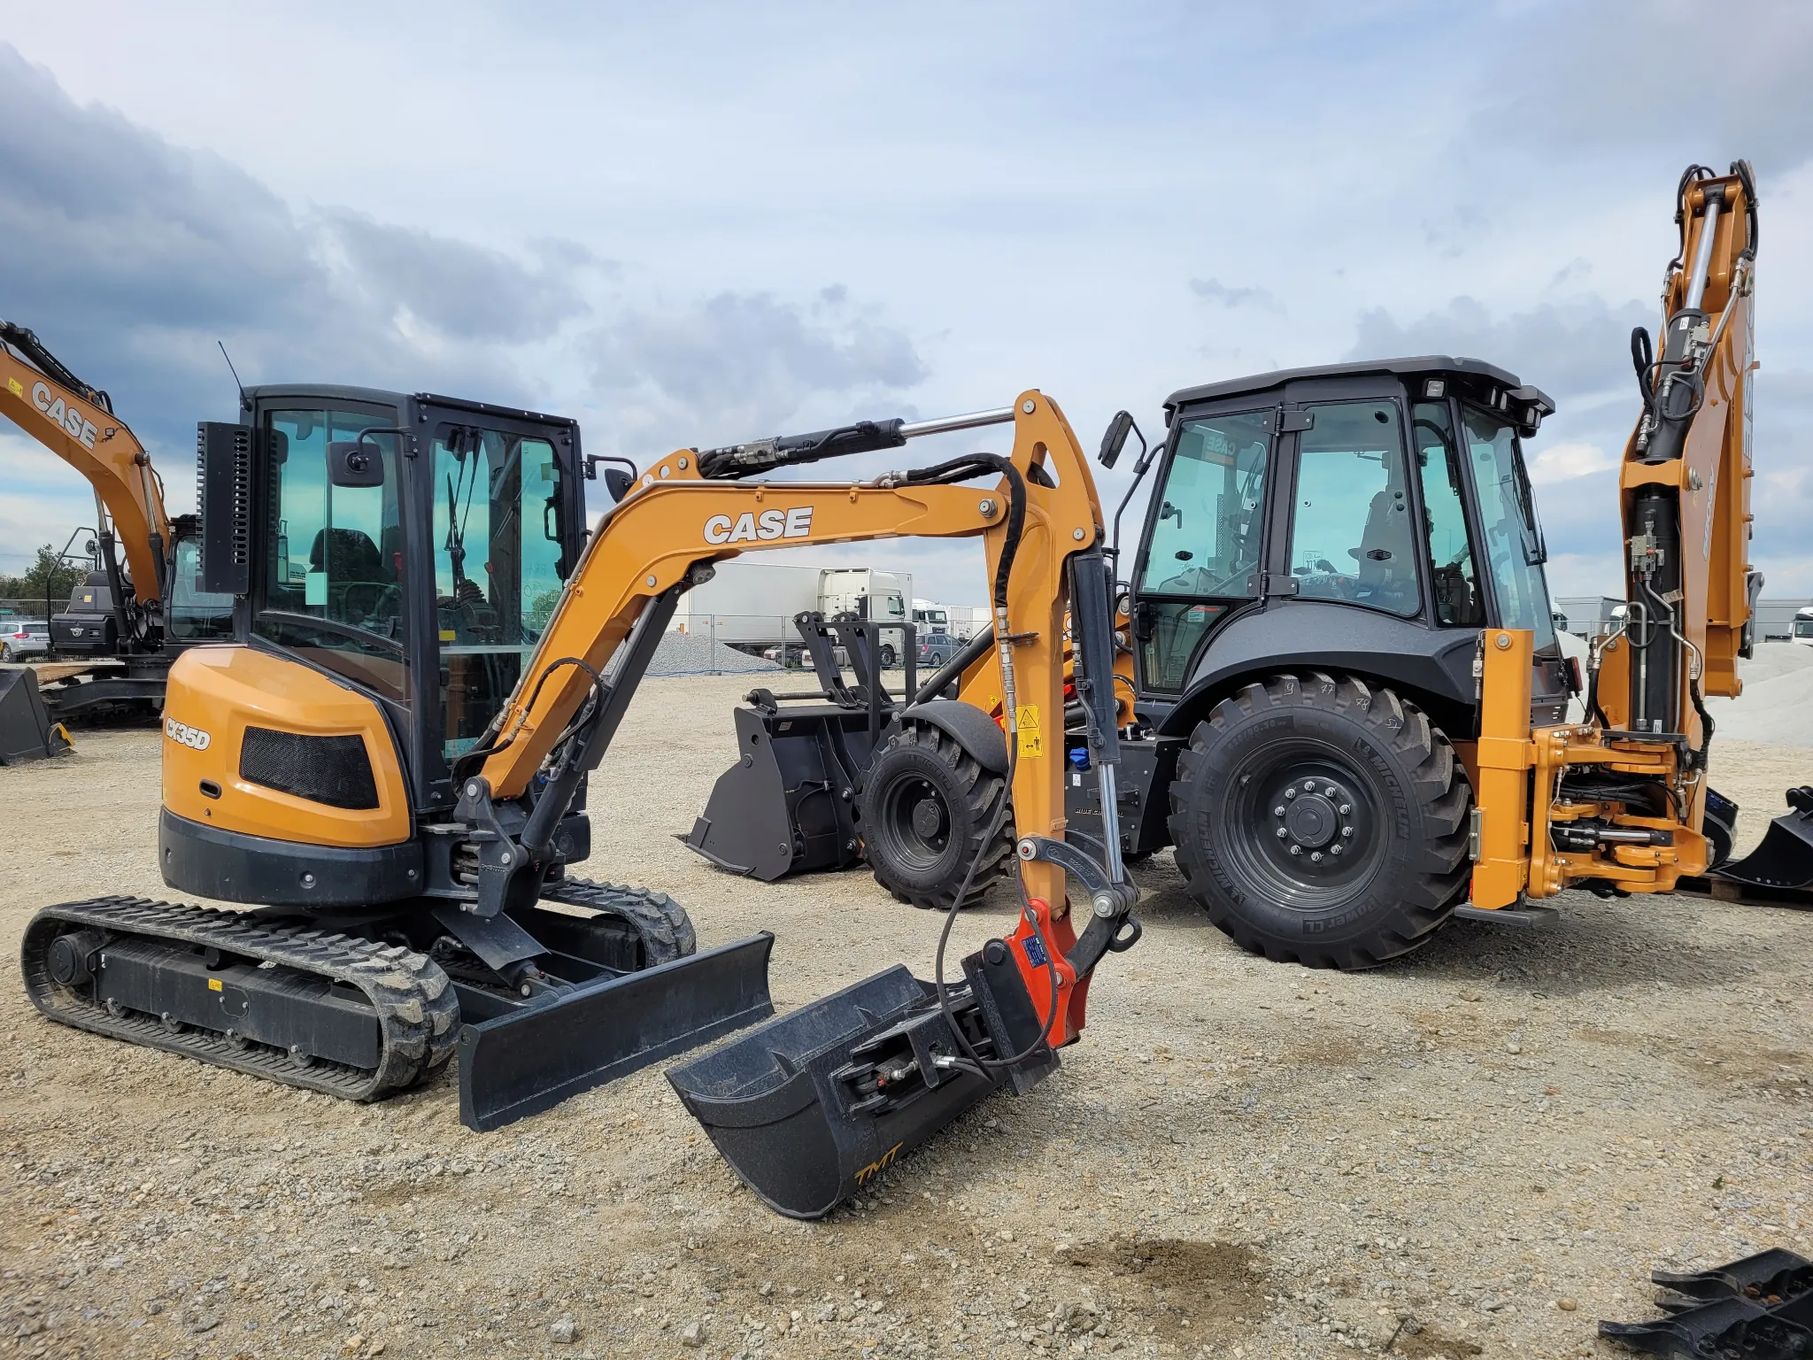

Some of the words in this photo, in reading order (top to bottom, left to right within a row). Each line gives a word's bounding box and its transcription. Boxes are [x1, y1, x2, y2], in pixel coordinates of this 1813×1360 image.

[32, 381, 98, 450] CASE
[704, 506, 814, 545] CASE
[1370, 753, 1411, 840] MICHELIN
[1196, 811, 1231, 889] MICHELIN
